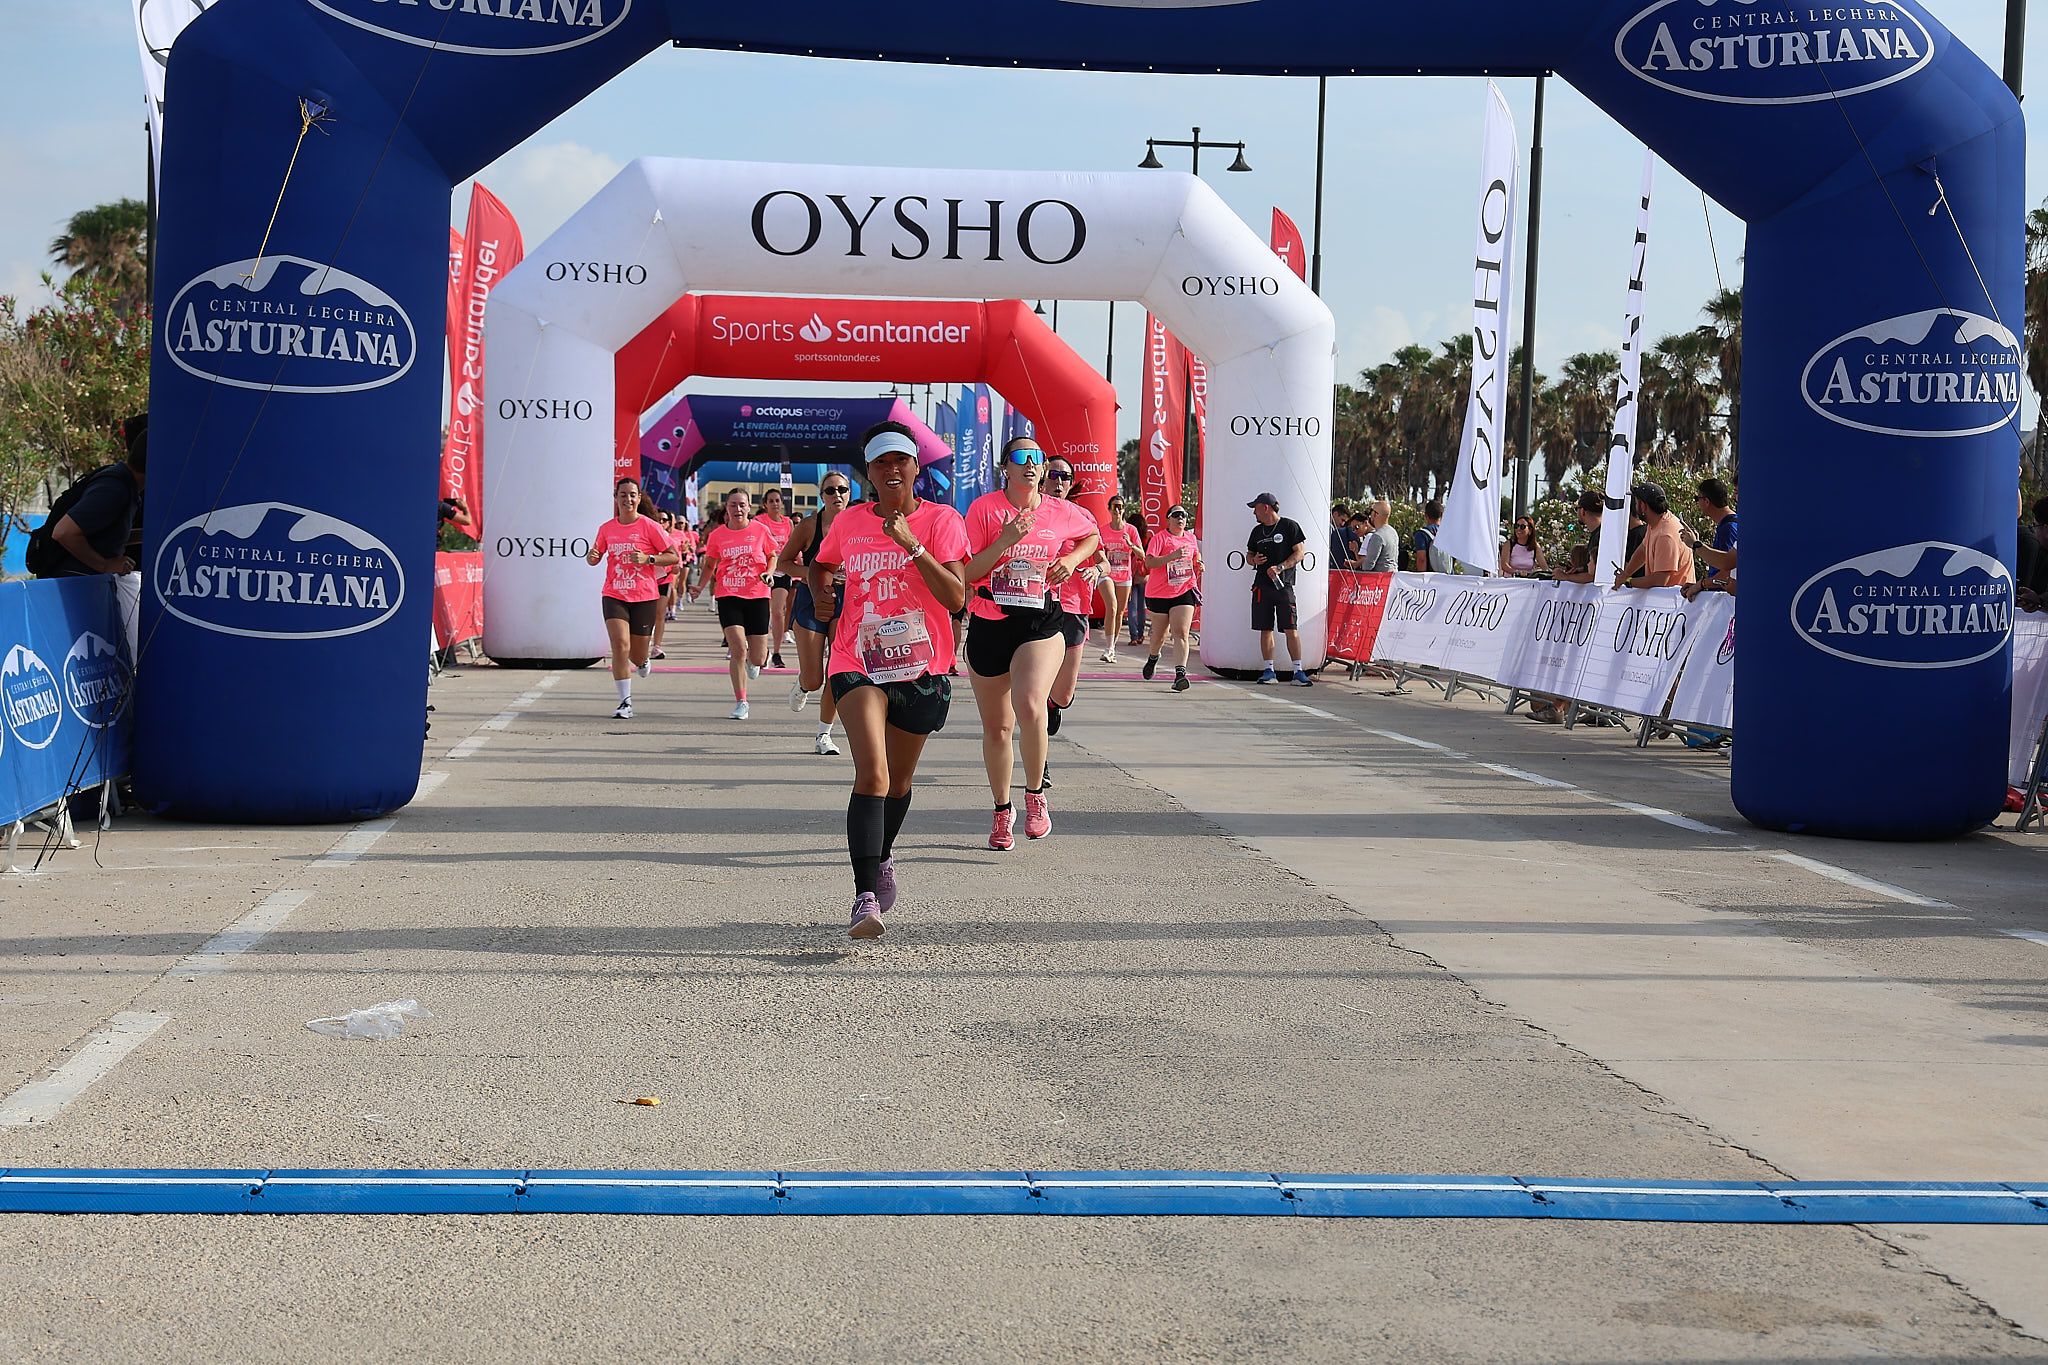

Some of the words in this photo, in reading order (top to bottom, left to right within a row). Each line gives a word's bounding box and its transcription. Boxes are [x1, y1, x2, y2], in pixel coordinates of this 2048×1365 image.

[1693, 10, 1799, 30] CENTRAL
[1809, 8, 1899, 22] LECHERA
[1641, 22, 1920, 71] ASTURIANA
[751, 190, 1087, 265] OYSHO
[545, 261, 648, 285] OYSHO
[1181, 276, 1279, 297] OYSHO
[209, 299, 298, 316] CENTRAL
[308, 304, 395, 327] LECHERA
[175, 302, 401, 368] ASTURIANA
[711, 315, 795, 345] Sports
[836, 318, 971, 344] Santander
[794, 352, 881, 364] sportssantander.es
[1865, 353, 1953, 366] CENTRAL
[1960, 352, 2016, 366] LECHERA
[1819, 356, 2018, 404] ASTURIANA
[498, 398, 593, 421] OYSHO
[756, 406, 803, 419] octopus
[803, 408, 843, 421] energy
[733, 422, 745, 430] LA
[746, 421, 784, 431] ENERGÍA
[785, 423, 810, 431] PARA
[811, 424, 847, 432] CORRER
[754, 431, 803, 439] VELOCIDAD
[1230, 415, 1321, 437] OYSHO
[1062, 442, 1099, 455] Sports
[1072, 461, 1113, 472] ntander
[198, 544, 287, 563] CENTRAL
[295, 550, 384, 570] LECHERA
[496, 537, 590, 558] OYSHO
[723, 545, 753, 558] CARRERA
[1004, 543, 1049, 559] ARRERA
[738, 556, 749, 567] DE
[164, 546, 389, 609] ASTURIANA
[723, 576, 746, 587] MUJER
[877, 577, 898, 601] DE
[1853, 584, 1941, 597] CENTRAL
[1948, 583, 2008, 597] LECHERA
[1810, 586, 2010, 635] ASTURIANA
[1535, 599, 1596, 647] OYSHO
[1613, 606, 1688, 661] OYSHO
[884, 644, 912, 658] 016
